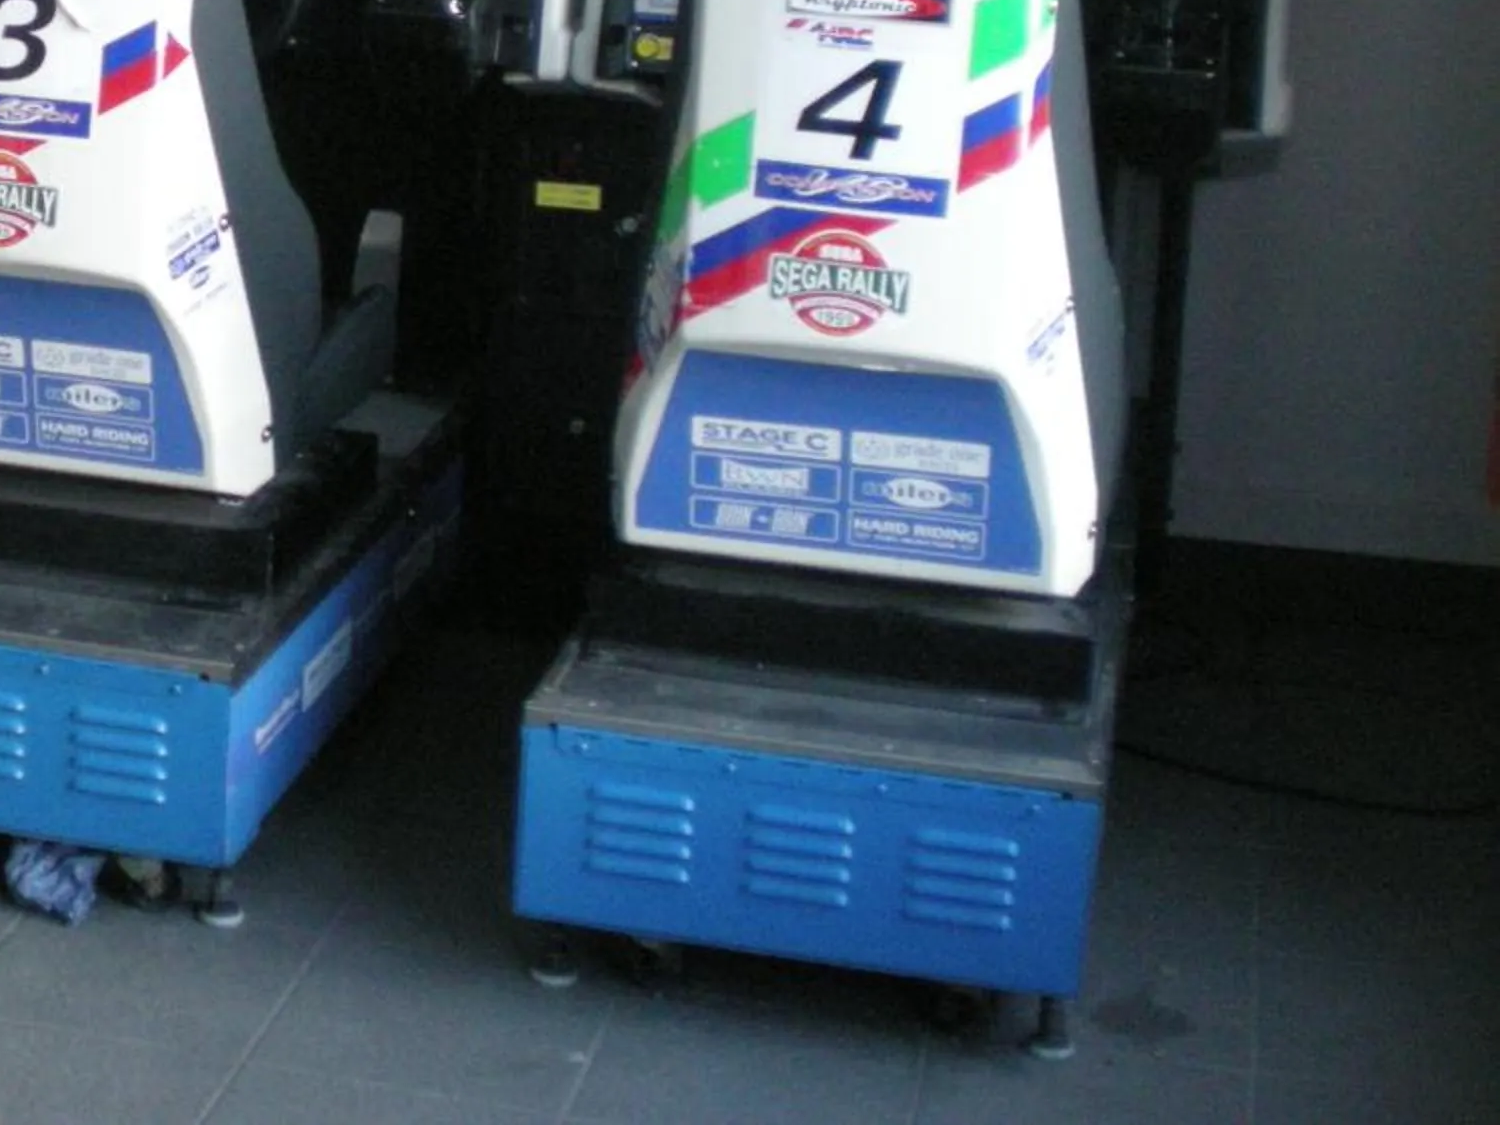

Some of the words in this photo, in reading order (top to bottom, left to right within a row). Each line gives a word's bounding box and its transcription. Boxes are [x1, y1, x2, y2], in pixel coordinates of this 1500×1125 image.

[795, 57, 906, 162] 4
[772, 258, 832, 298] SEGA
[837, 267, 909, 314] RALLY
[703, 422, 798, 445] STAGE
[805, 431, 829, 451] C
